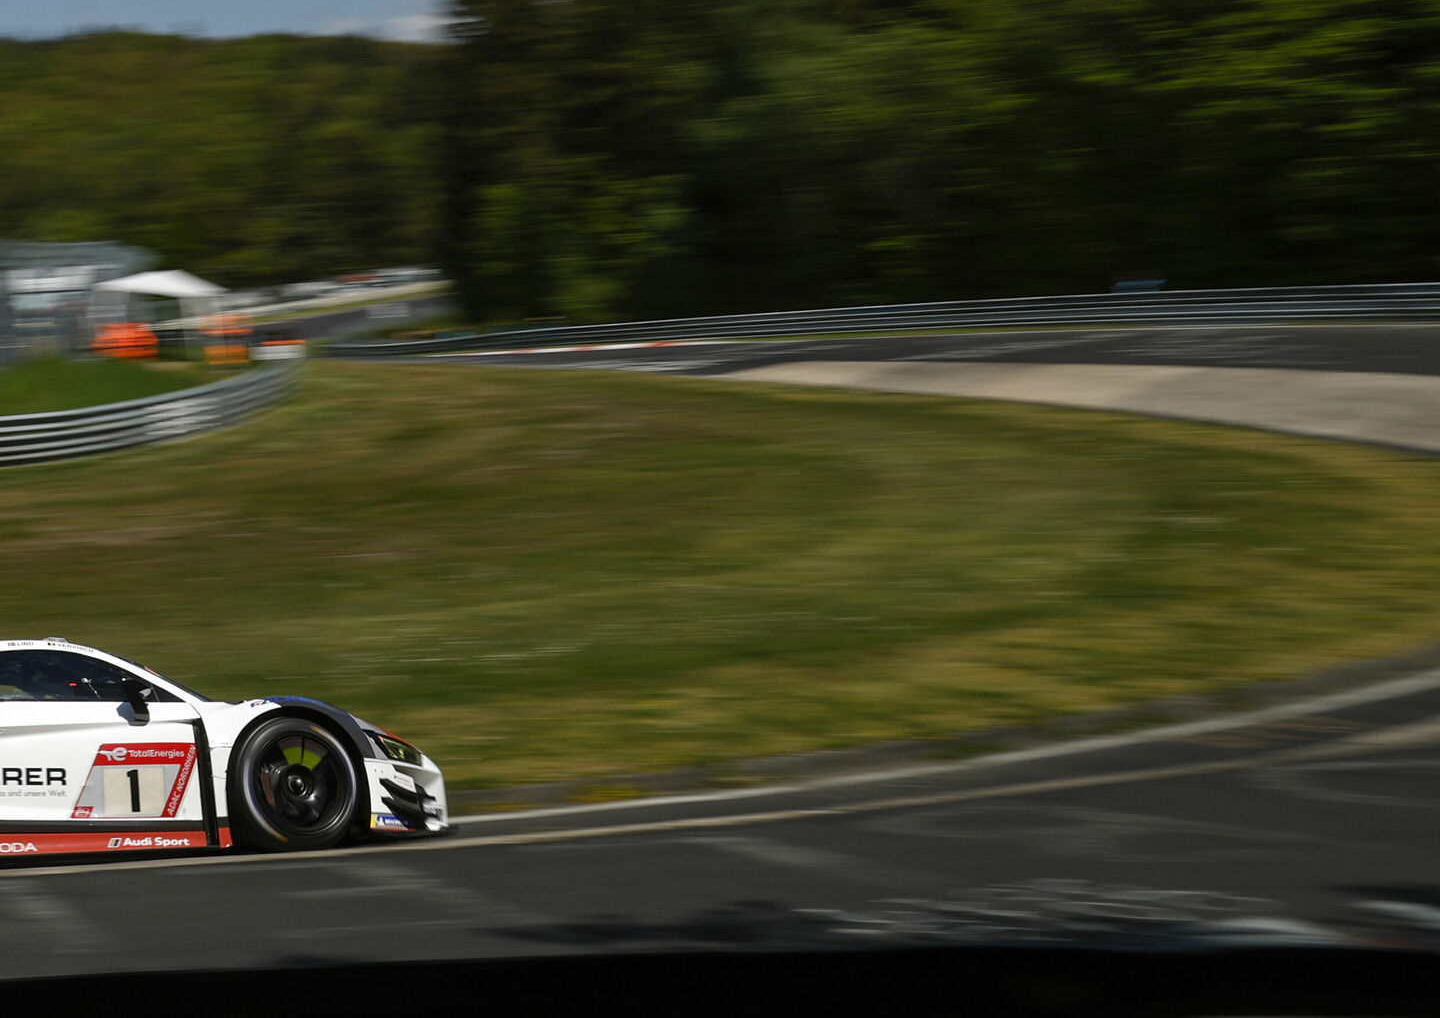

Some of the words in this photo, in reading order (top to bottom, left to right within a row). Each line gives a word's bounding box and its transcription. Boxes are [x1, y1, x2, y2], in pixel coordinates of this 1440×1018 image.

[129, 749, 185, 759] TotalEnergies
[126, 769, 141, 813] 1
[167, 791, 180, 816] ADAC
[123, 837, 153, 847] Audi
[154, 836, 191, 847] Sport
